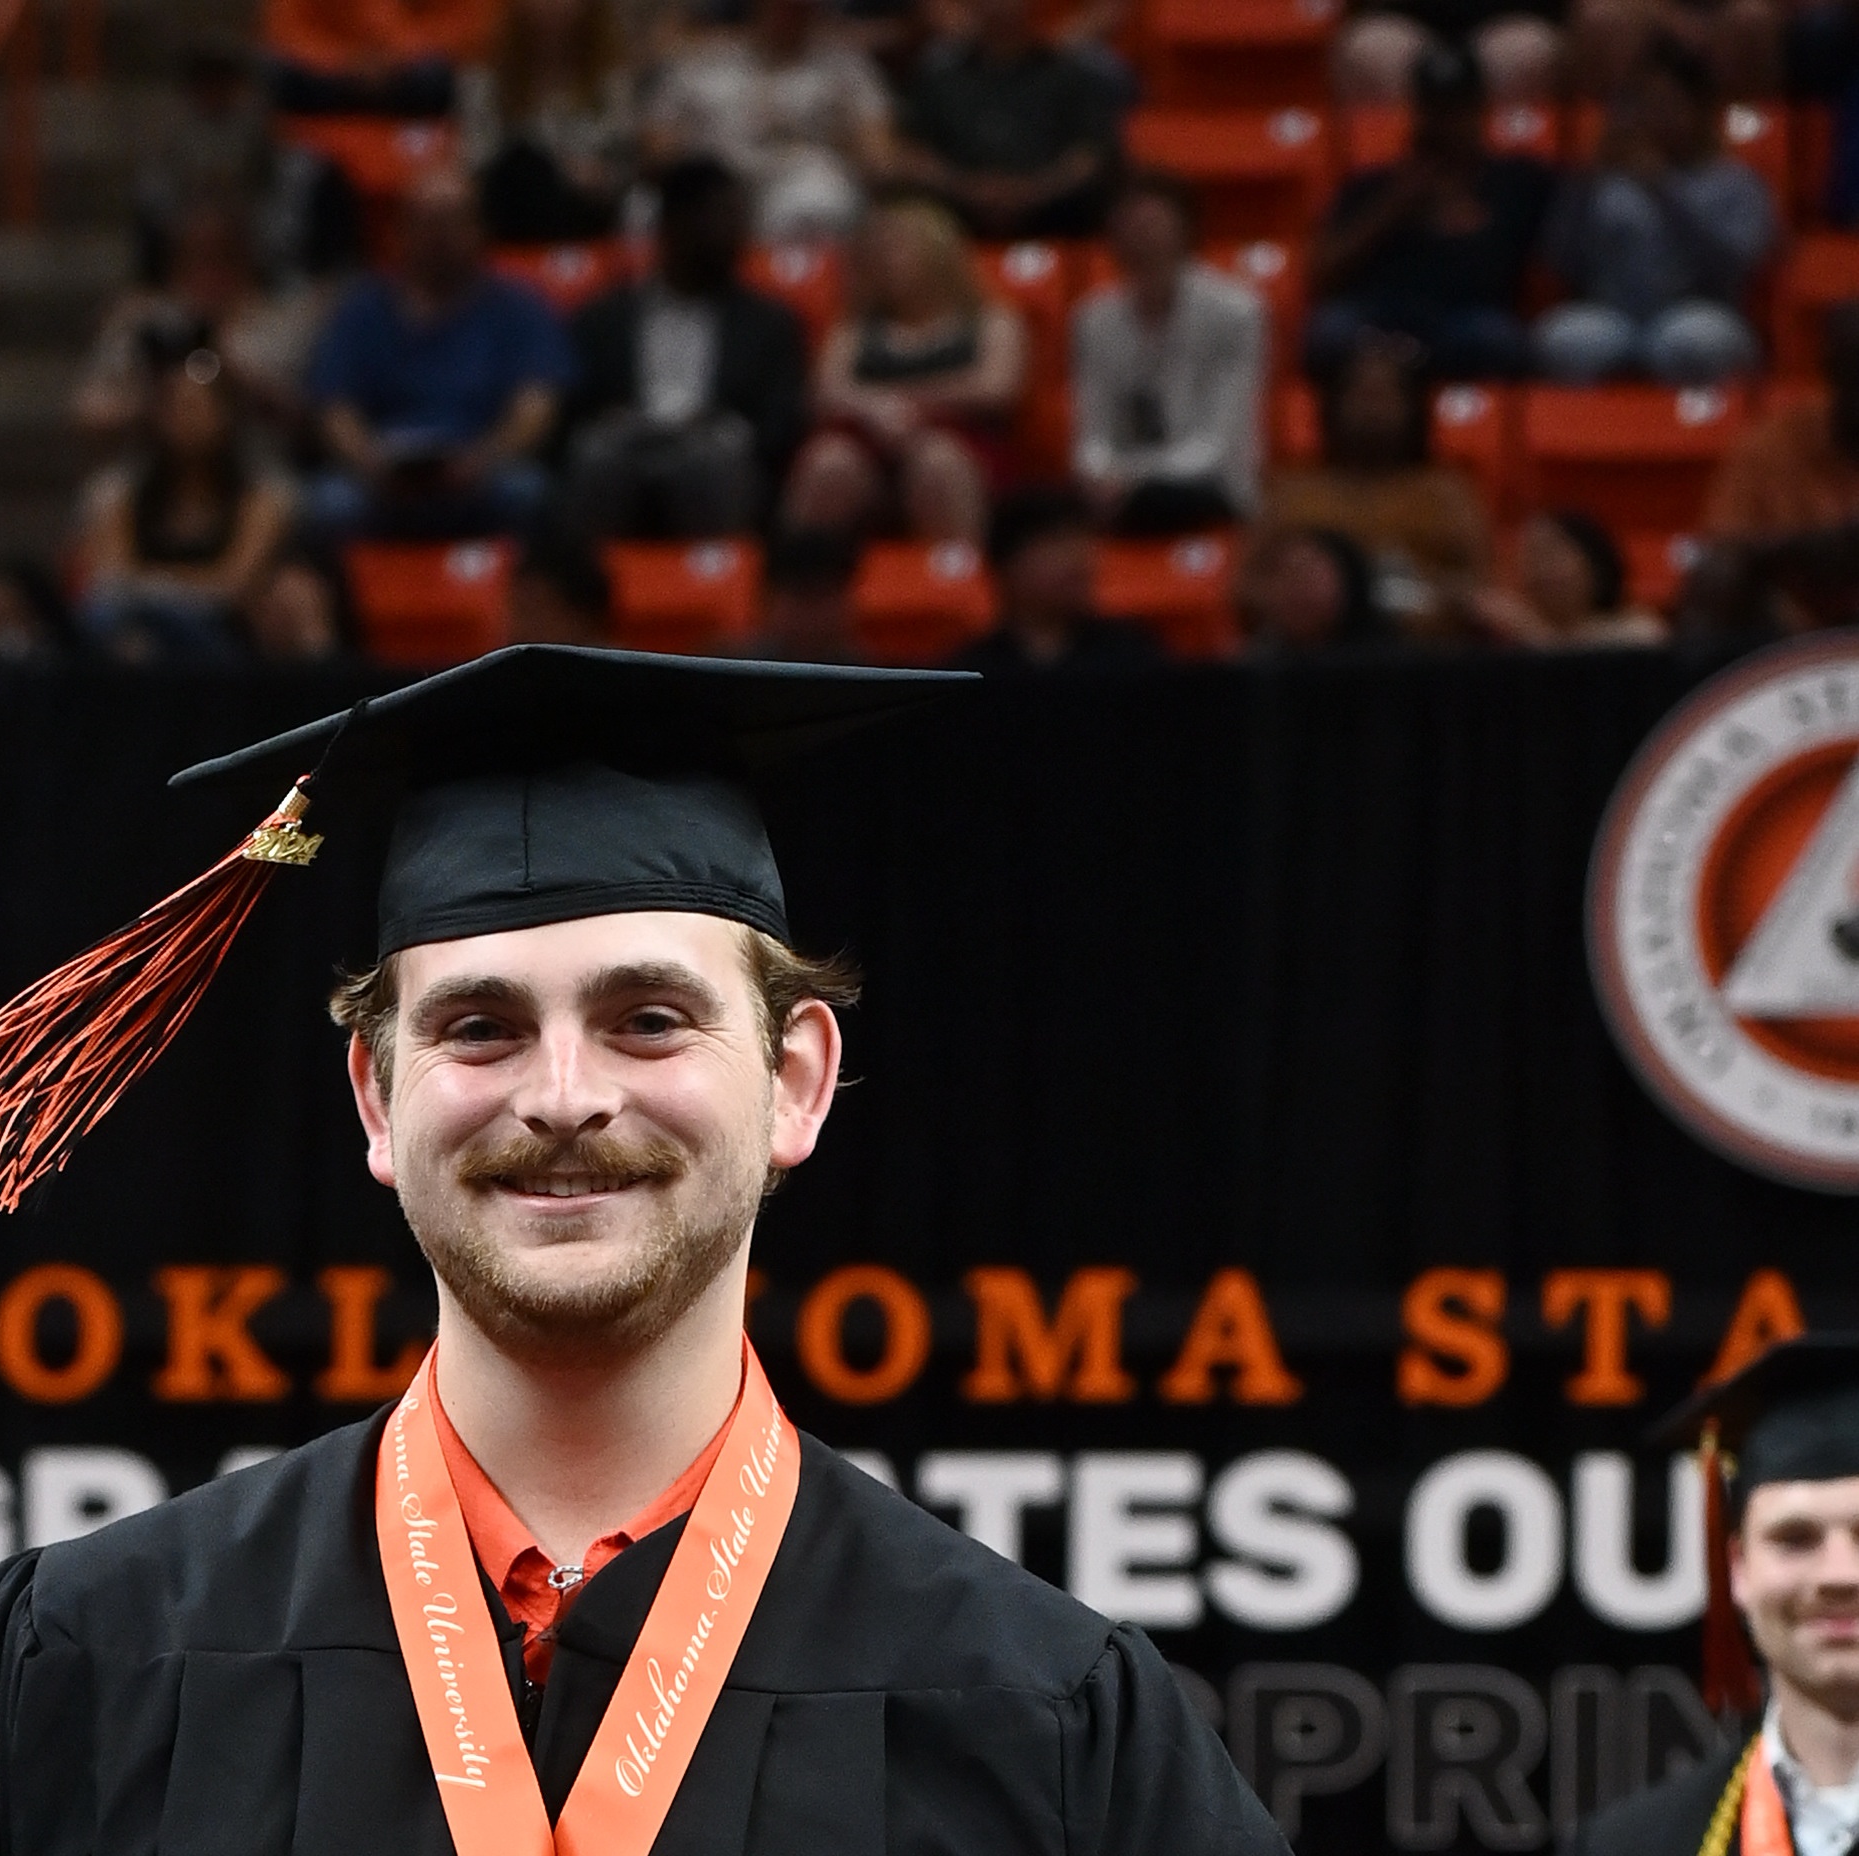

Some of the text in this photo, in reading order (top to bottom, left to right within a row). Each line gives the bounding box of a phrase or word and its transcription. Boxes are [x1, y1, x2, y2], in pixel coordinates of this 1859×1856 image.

[398, 1492, 439, 1587] State
[422, 1592, 491, 1792] University
[615, 1610, 719, 1797] Oklahoma
[706, 1506, 755, 1606] State
[1404, 1446, 1710, 1634] OU
